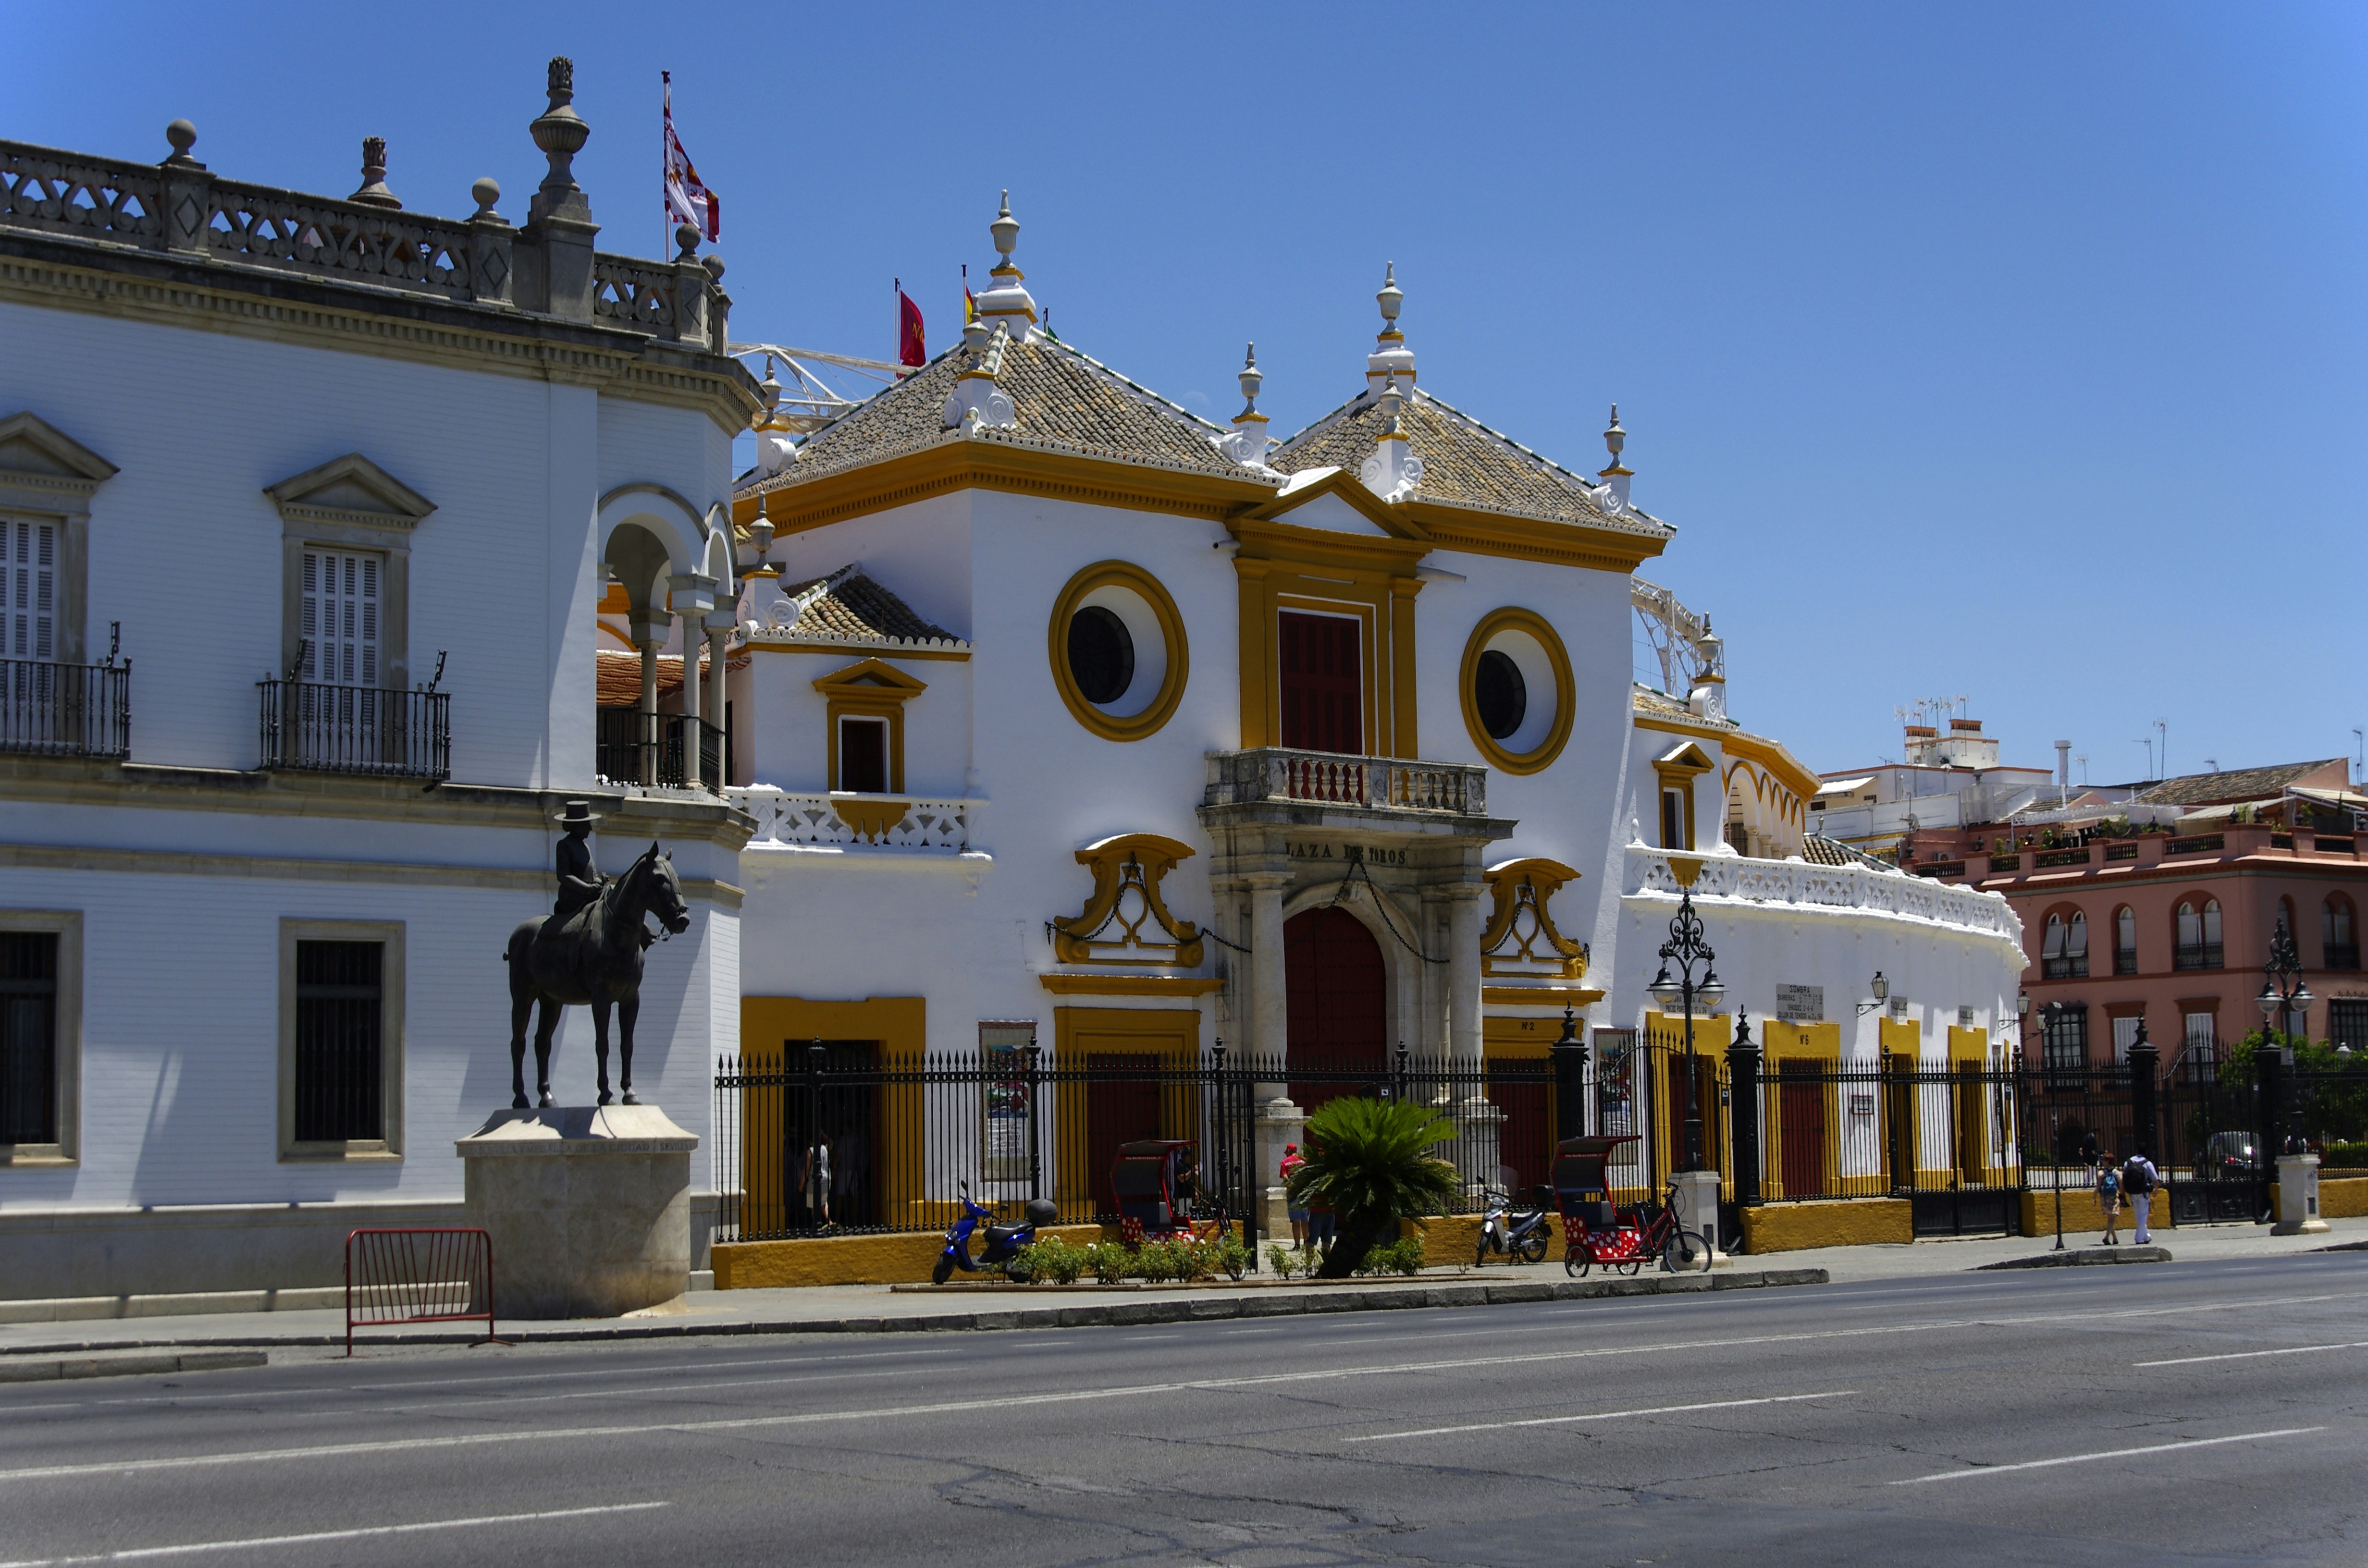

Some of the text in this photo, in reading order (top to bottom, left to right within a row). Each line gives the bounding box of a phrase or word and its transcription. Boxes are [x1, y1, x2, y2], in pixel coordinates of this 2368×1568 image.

[1285, 843, 1406, 864] LAZA DE TOROS
[1789, 985, 1810, 993] SOMBRA
[1530, 1022, 1534, 1030] 2
[1805, 1034, 1809, 1045] 6
[609, 1143, 649, 1152] CIUDAD
